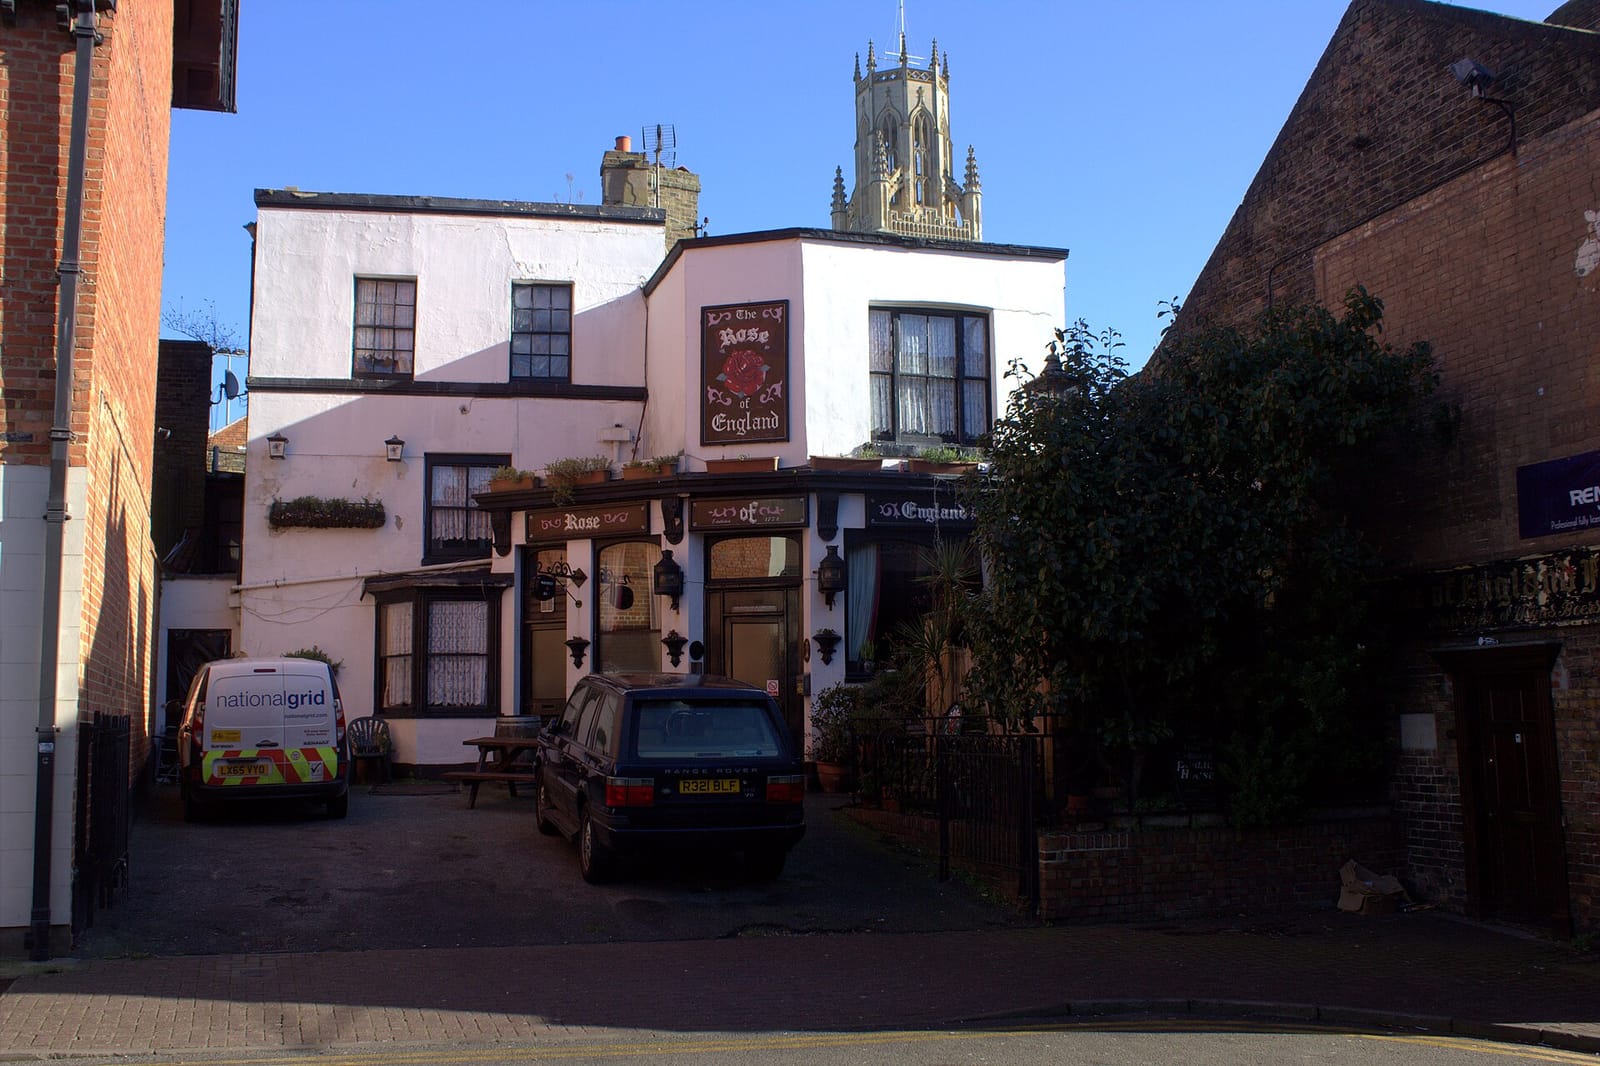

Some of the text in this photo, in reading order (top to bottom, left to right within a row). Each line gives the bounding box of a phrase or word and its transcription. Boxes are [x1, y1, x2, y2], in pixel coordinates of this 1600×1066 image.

[735, 309, 757, 321] The
[718, 327, 770, 350] Rose
[739, 397, 751, 410] of
[711, 411, 780, 437] England
[739, 501, 758, 525] of
[901, 501, 968, 523] England
[563, 513, 601, 531] Rose
[216, 690, 326, 709] nationalgrid
[220, 765, 246, 776] LX65
[664, 766, 759, 775] RANGE ROVER
[683, 781, 710, 792] R321
[713, 780, 738, 792] BLF
